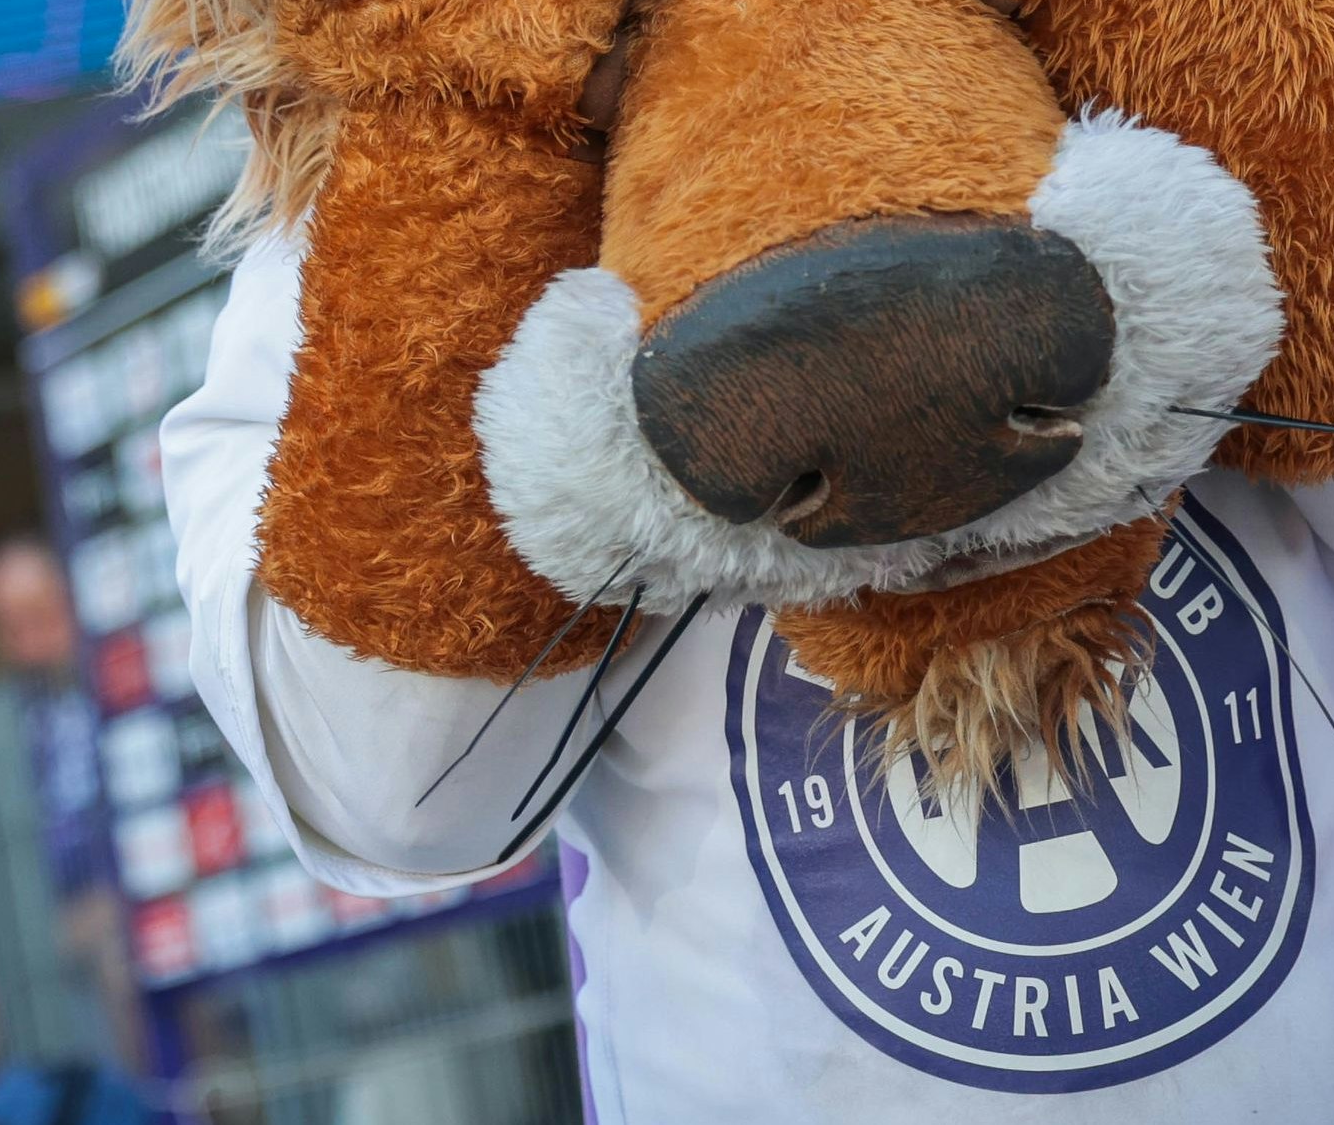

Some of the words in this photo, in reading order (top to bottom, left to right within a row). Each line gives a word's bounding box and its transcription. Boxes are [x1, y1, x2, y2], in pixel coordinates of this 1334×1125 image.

[1150, 542, 1224, 635] UB
[1223, 687, 1263, 744] 11
[777, 774, 834, 834] 19
[1149, 831, 1276, 992] WIEN
[838, 905, 1140, 1038] AUSTRIA
